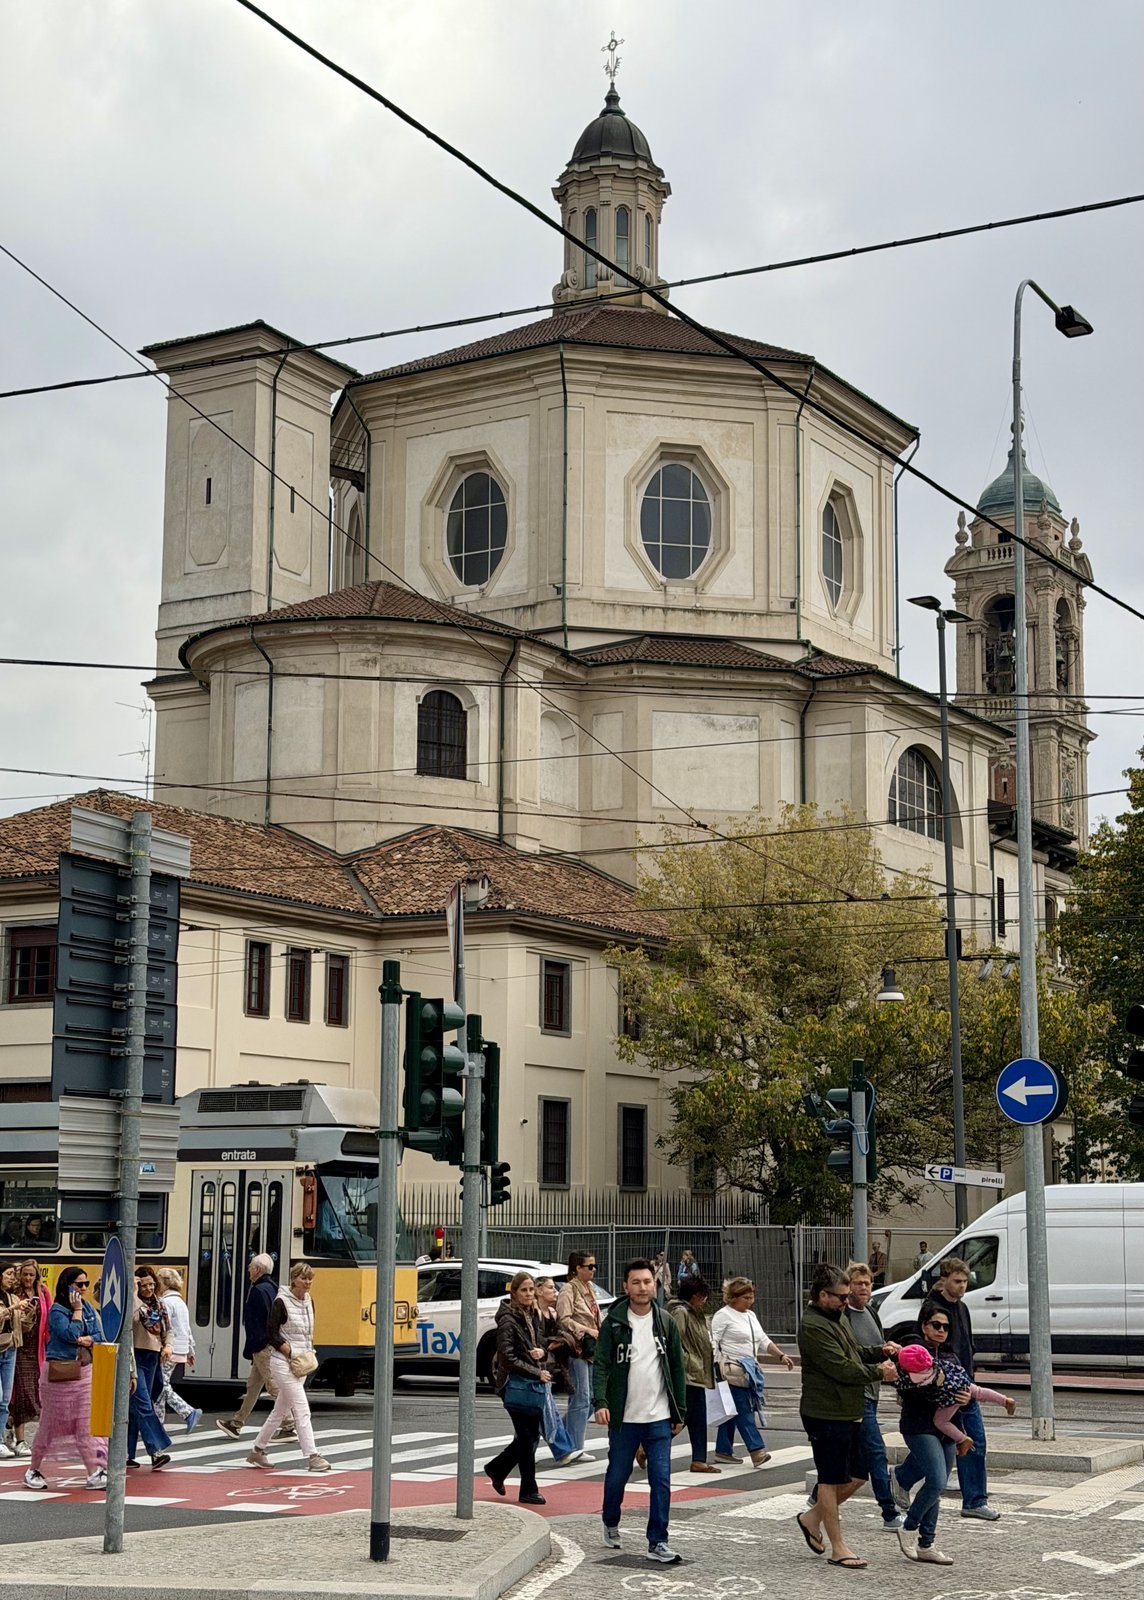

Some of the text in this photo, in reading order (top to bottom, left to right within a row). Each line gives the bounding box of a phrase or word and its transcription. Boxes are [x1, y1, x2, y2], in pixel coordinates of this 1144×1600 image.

[221, 1149, 257, 1161] entrata
[943, 1169, 951, 1179] P
[981, 1176, 1003, 1185] pirelli
[416, 1323, 461, 1354] Tax
